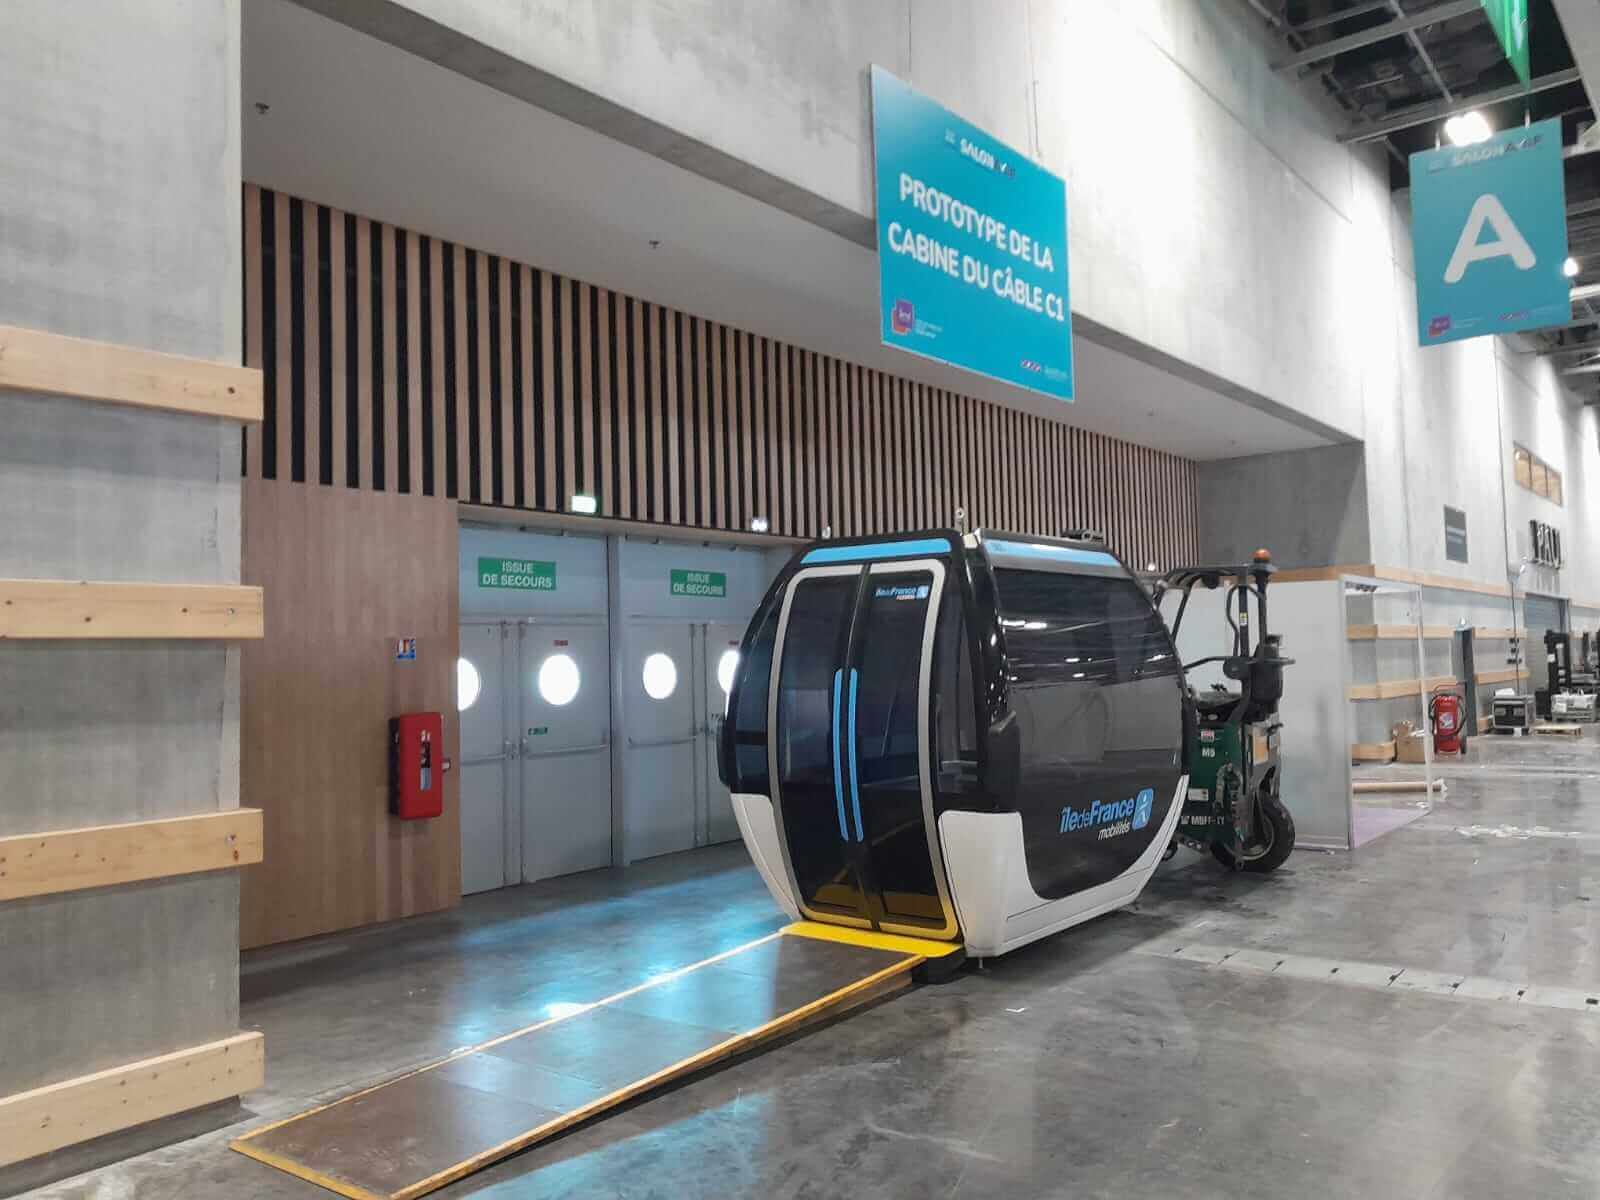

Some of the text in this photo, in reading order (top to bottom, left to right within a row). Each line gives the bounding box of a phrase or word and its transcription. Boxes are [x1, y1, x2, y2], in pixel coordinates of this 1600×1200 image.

[900, 173, 1054, 272] PROTOTYPE DE LA
[1444, 194, 1536, 284] A
[888, 222, 1065, 322] CABINE DU CÂBLE C1
[502, 560, 534, 574] ISSUE
[482, 573, 552, 589] DE SECOURS
[687, 572, 710, 584] ISSUE
[673, 583, 723, 596] DE SECOURS
